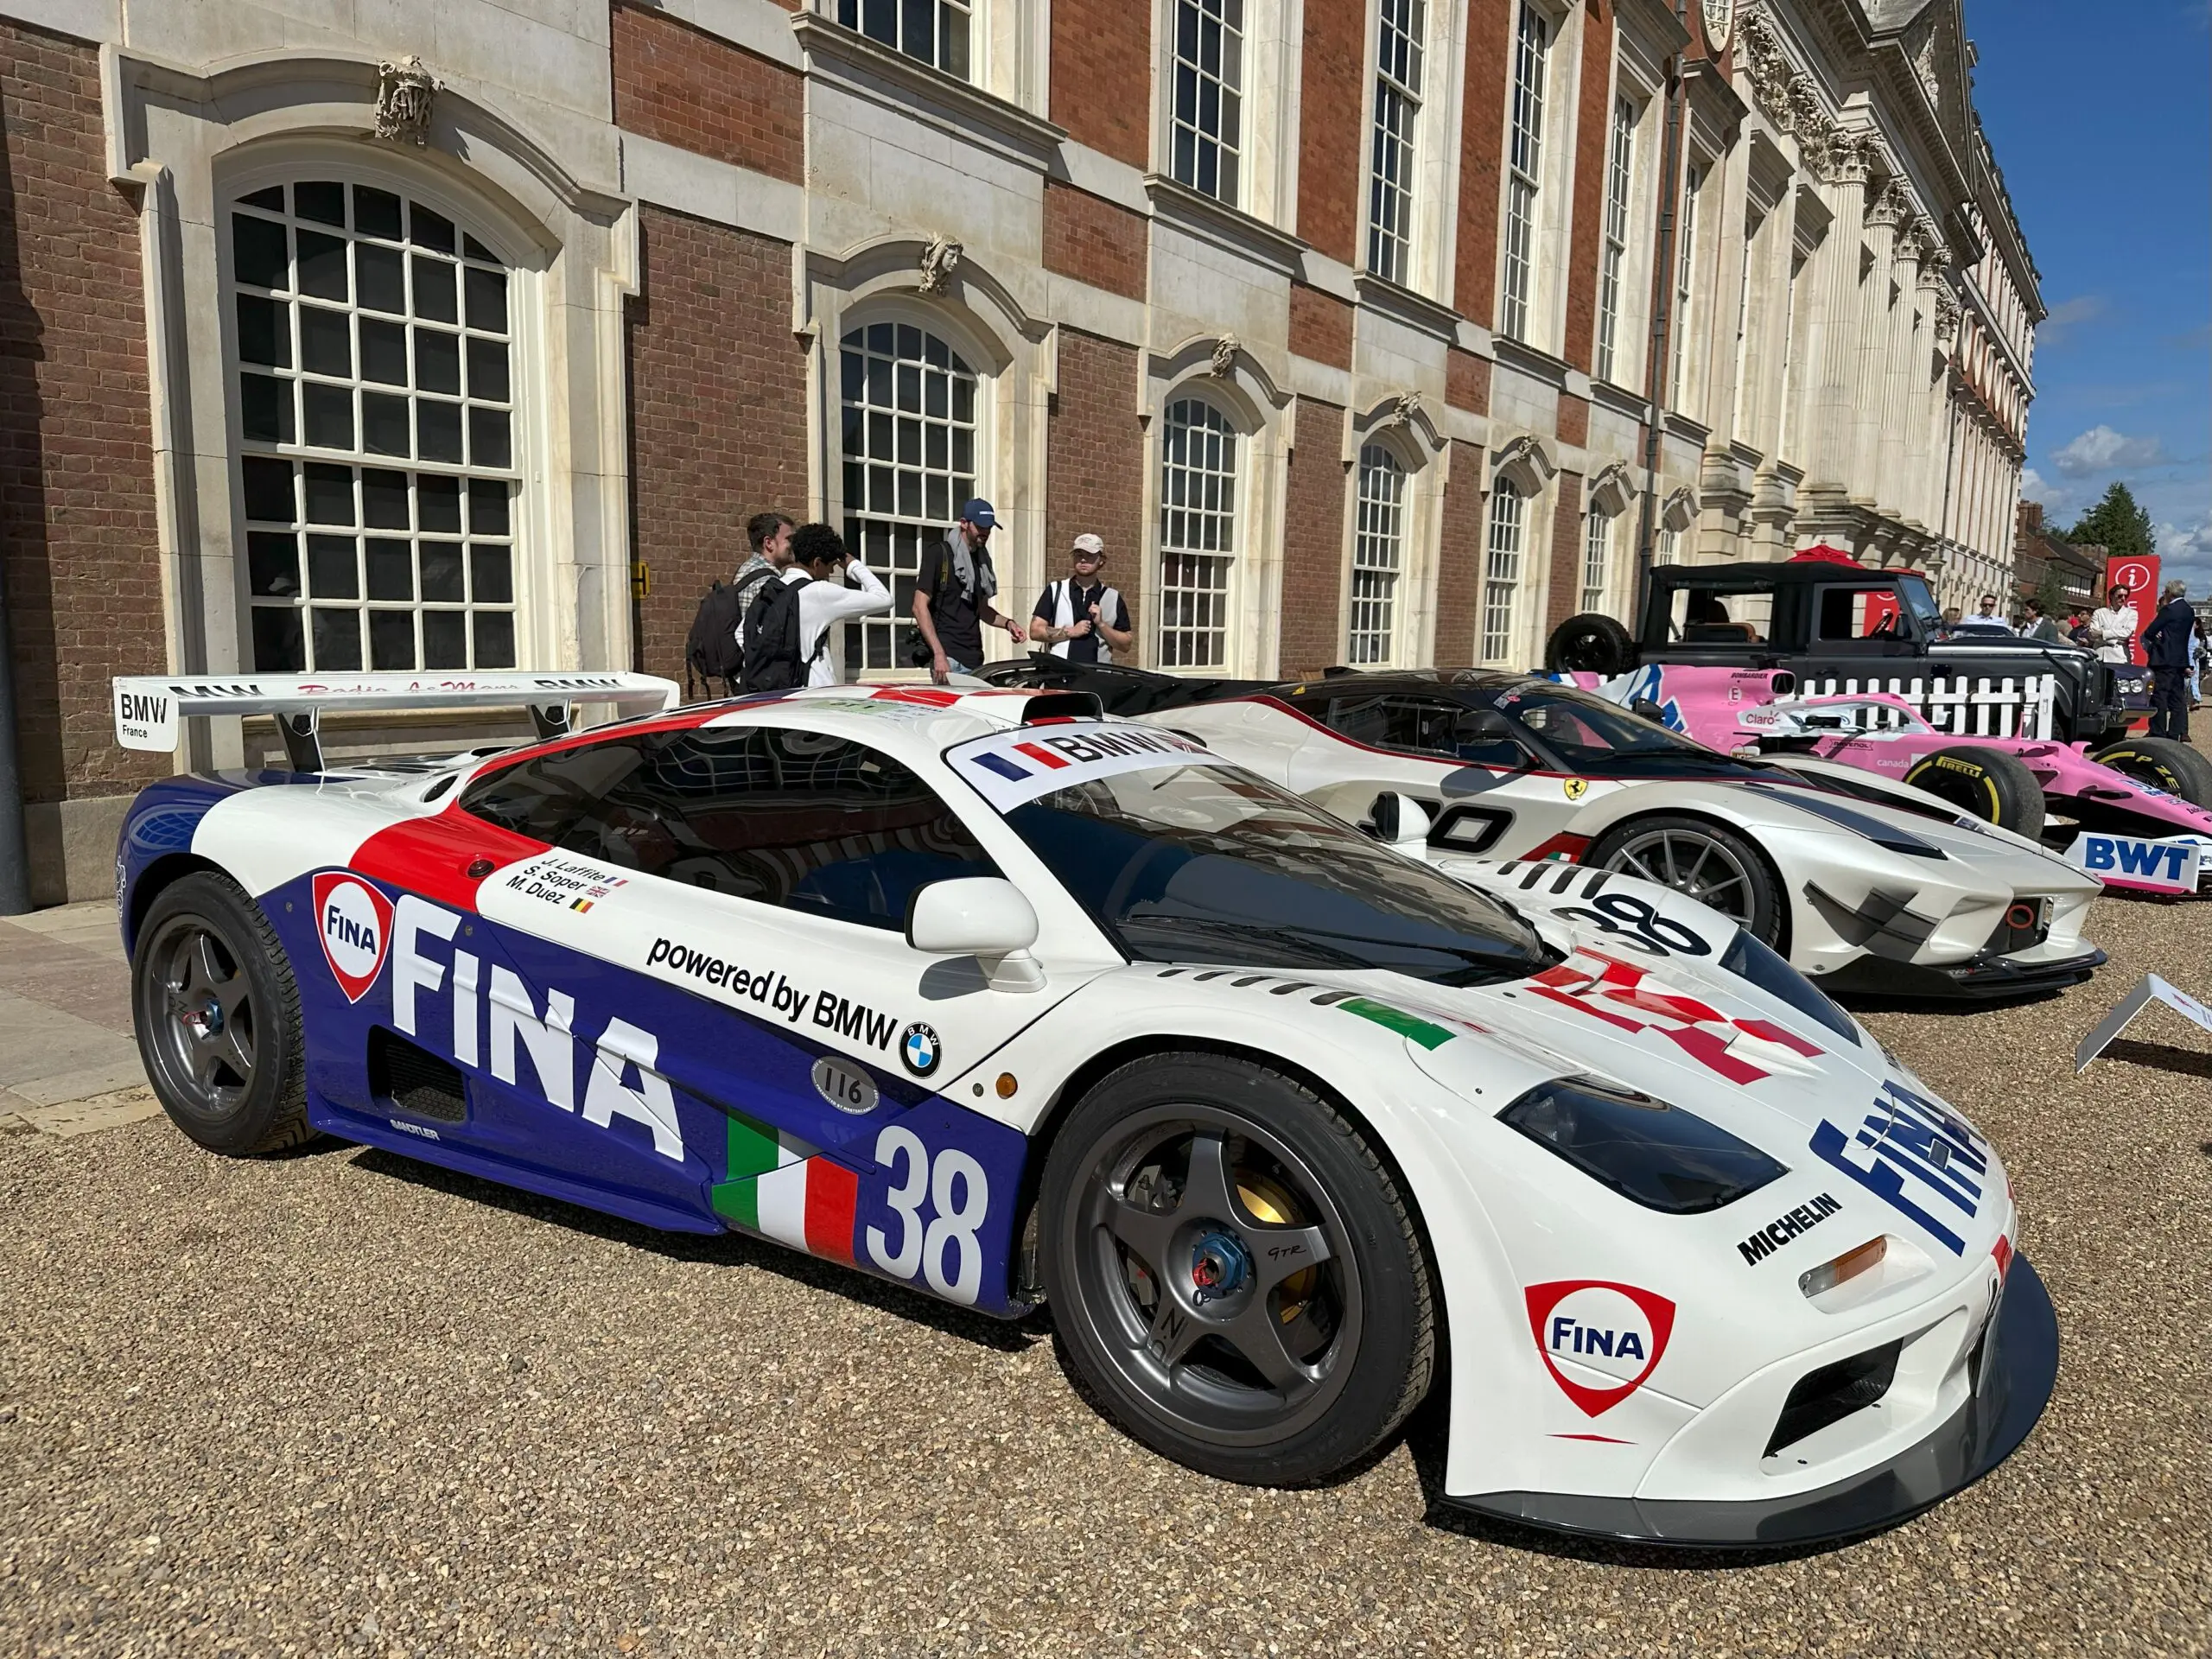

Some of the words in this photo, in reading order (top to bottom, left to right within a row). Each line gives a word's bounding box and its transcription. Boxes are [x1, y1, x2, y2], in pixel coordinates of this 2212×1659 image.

[169, 684, 264, 696] MW
[120, 694, 168, 724] BMW
[1745, 714, 1775, 726] Claro
[122, 725, 148, 739] France
[1041, 732, 1172, 763] BMW
[1877, 759, 1909, 768] canada
[1936, 755, 1984, 779] PIRELLI
[557, 862, 606, 880] Laffite
[2085, 837, 2189, 880] BWT
[505, 875, 523, 891] M.
[525, 882, 566, 904] Duez
[524, 866, 540, 877] S.
[541, 871, 587, 890] Soper
[327, 905, 377, 956] FINA
[1551, 893, 1713, 957] 38
[646, 937, 775, 1003] powered
[771, 976, 809, 1023] by
[812, 990, 898, 1051] BMW
[392, 894, 685, 1162] FINA
[907, 1024, 939, 1046] BMW
[824, 1067, 862, 1104] 116
[1809, 1079, 1987, 1258] FINA
[867, 1125, 989, 1306] 38
[1737, 1192, 1843, 1268] MICHELIN
[1553, 1317, 1644, 1361] FINA
